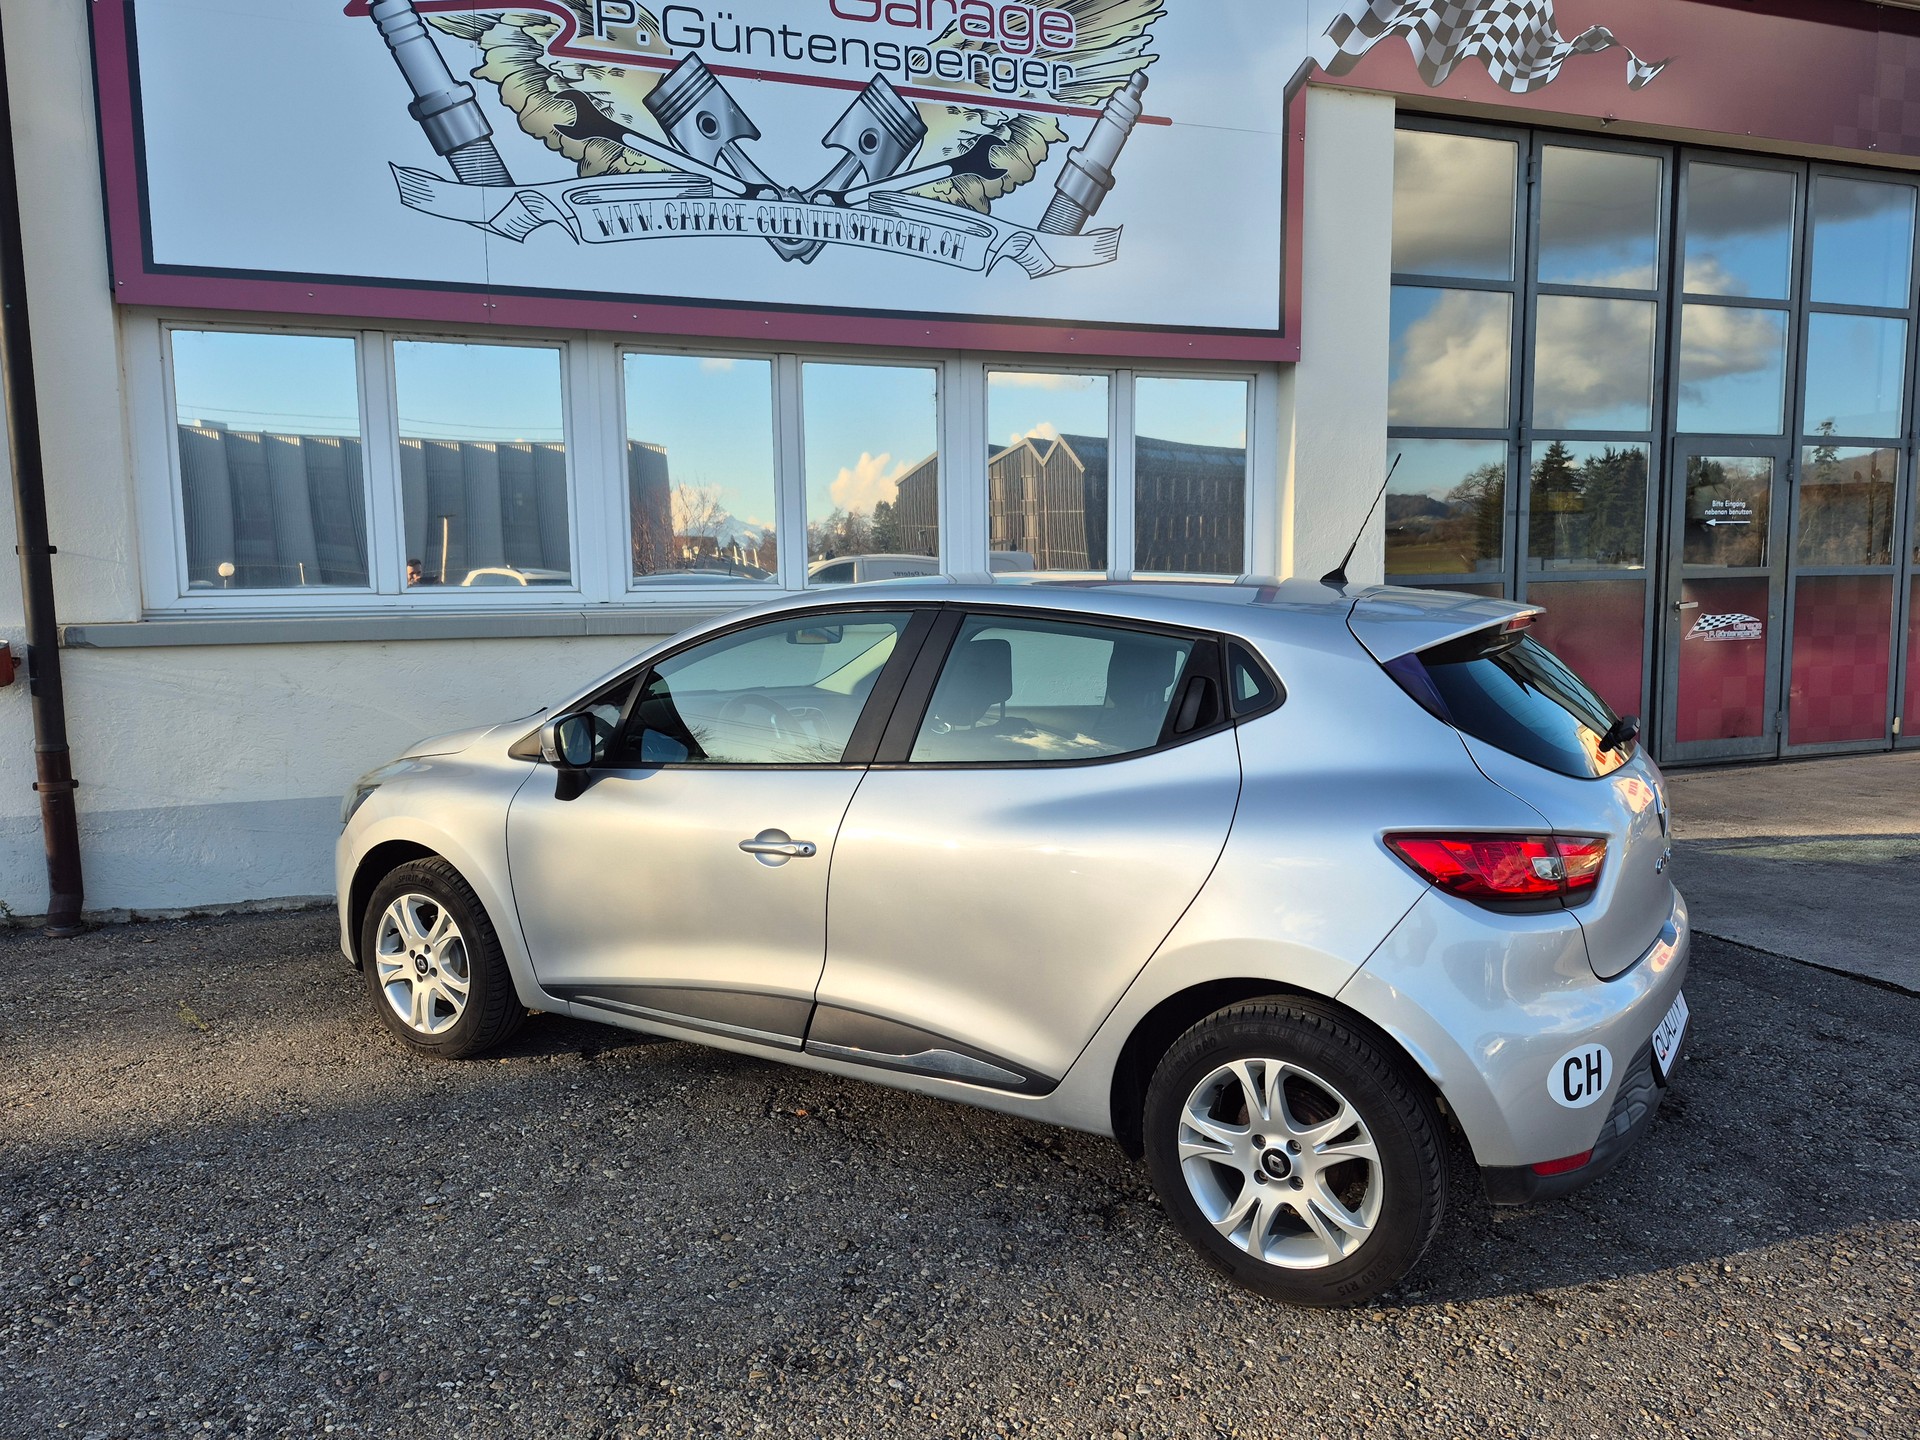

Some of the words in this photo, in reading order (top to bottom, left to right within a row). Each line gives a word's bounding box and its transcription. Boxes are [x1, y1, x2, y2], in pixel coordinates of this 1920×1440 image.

[598, 0, 647, 42] P.
[662, 5, 1074, 93] Güntensperger
[592, 202, 967, 262] WWW.GARAGE-GUENTENSPERGER.CH
[1725, 500, 1746, 508] Eingang
[1562, 1049, 1602, 1102] CH
